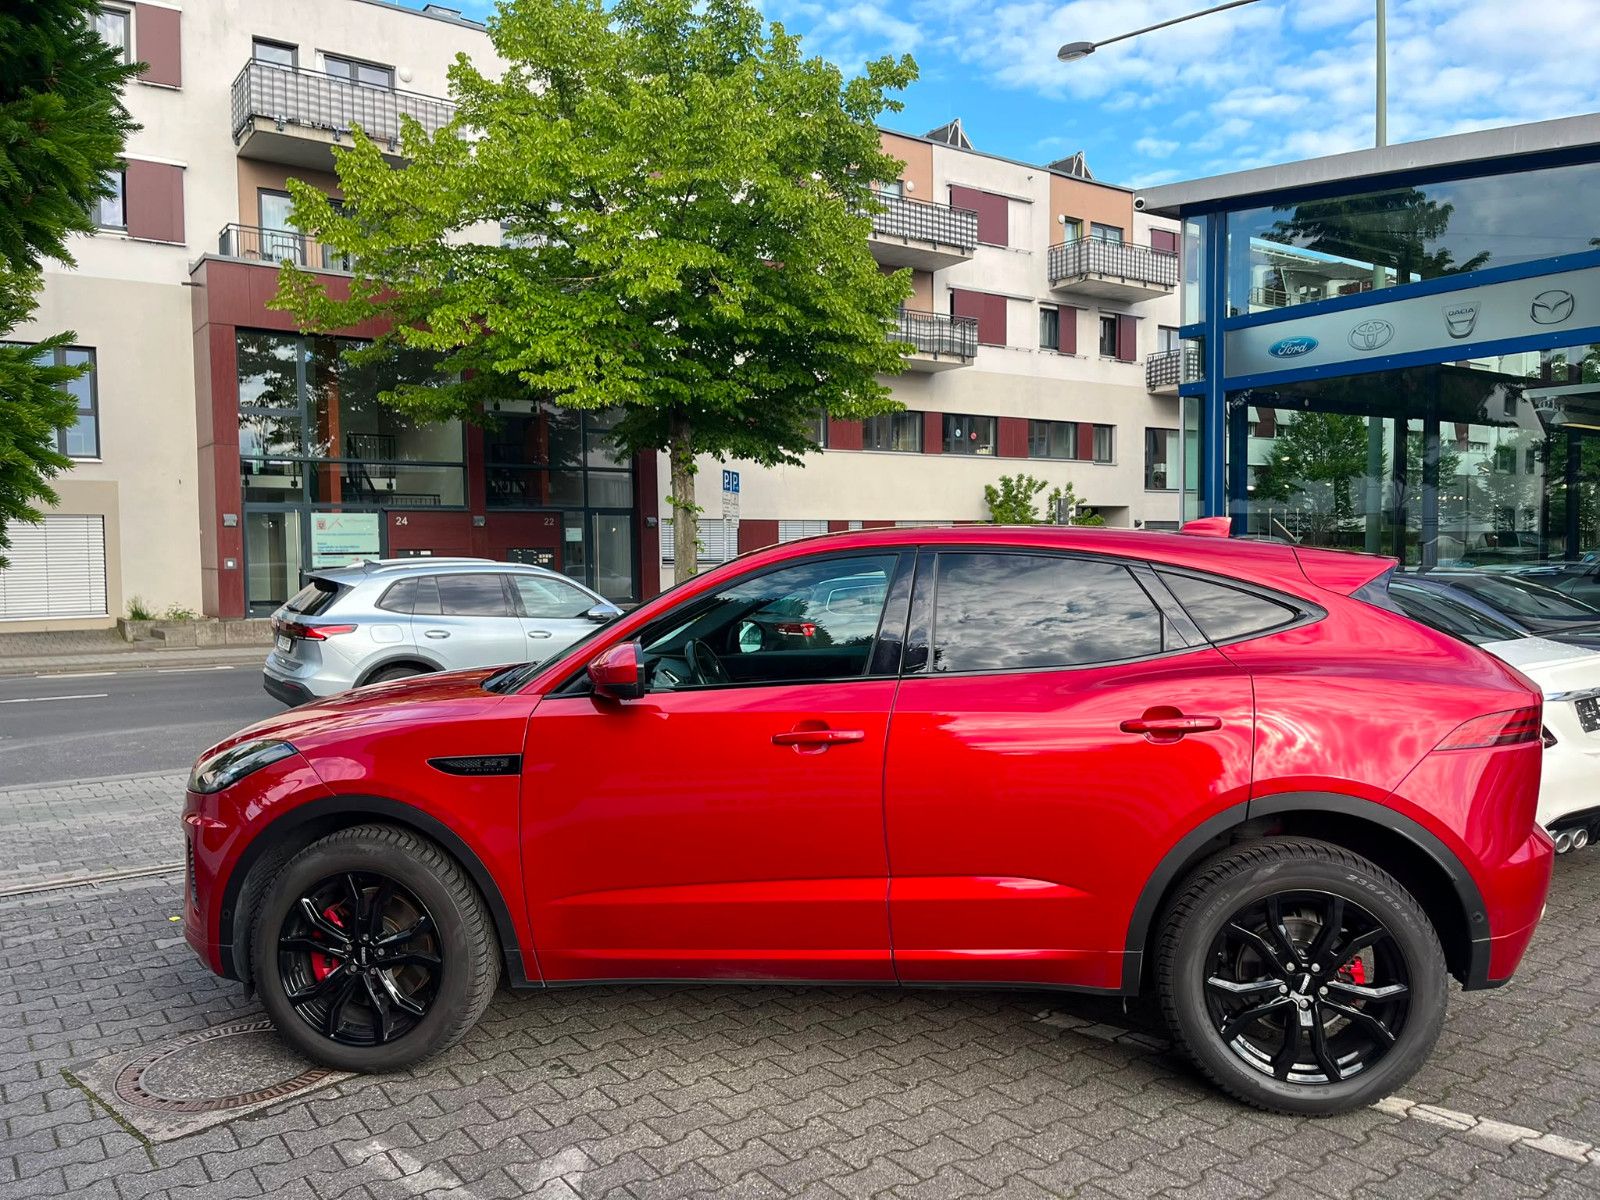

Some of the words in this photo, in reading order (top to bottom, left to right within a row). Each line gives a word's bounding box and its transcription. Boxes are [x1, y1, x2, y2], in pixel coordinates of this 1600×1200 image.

[1448, 307, 1474, 317] DACIA
[1277, 338, 1309, 355] Ford
[395, 516, 408, 526] 24
[544, 517, 555, 526] 22
